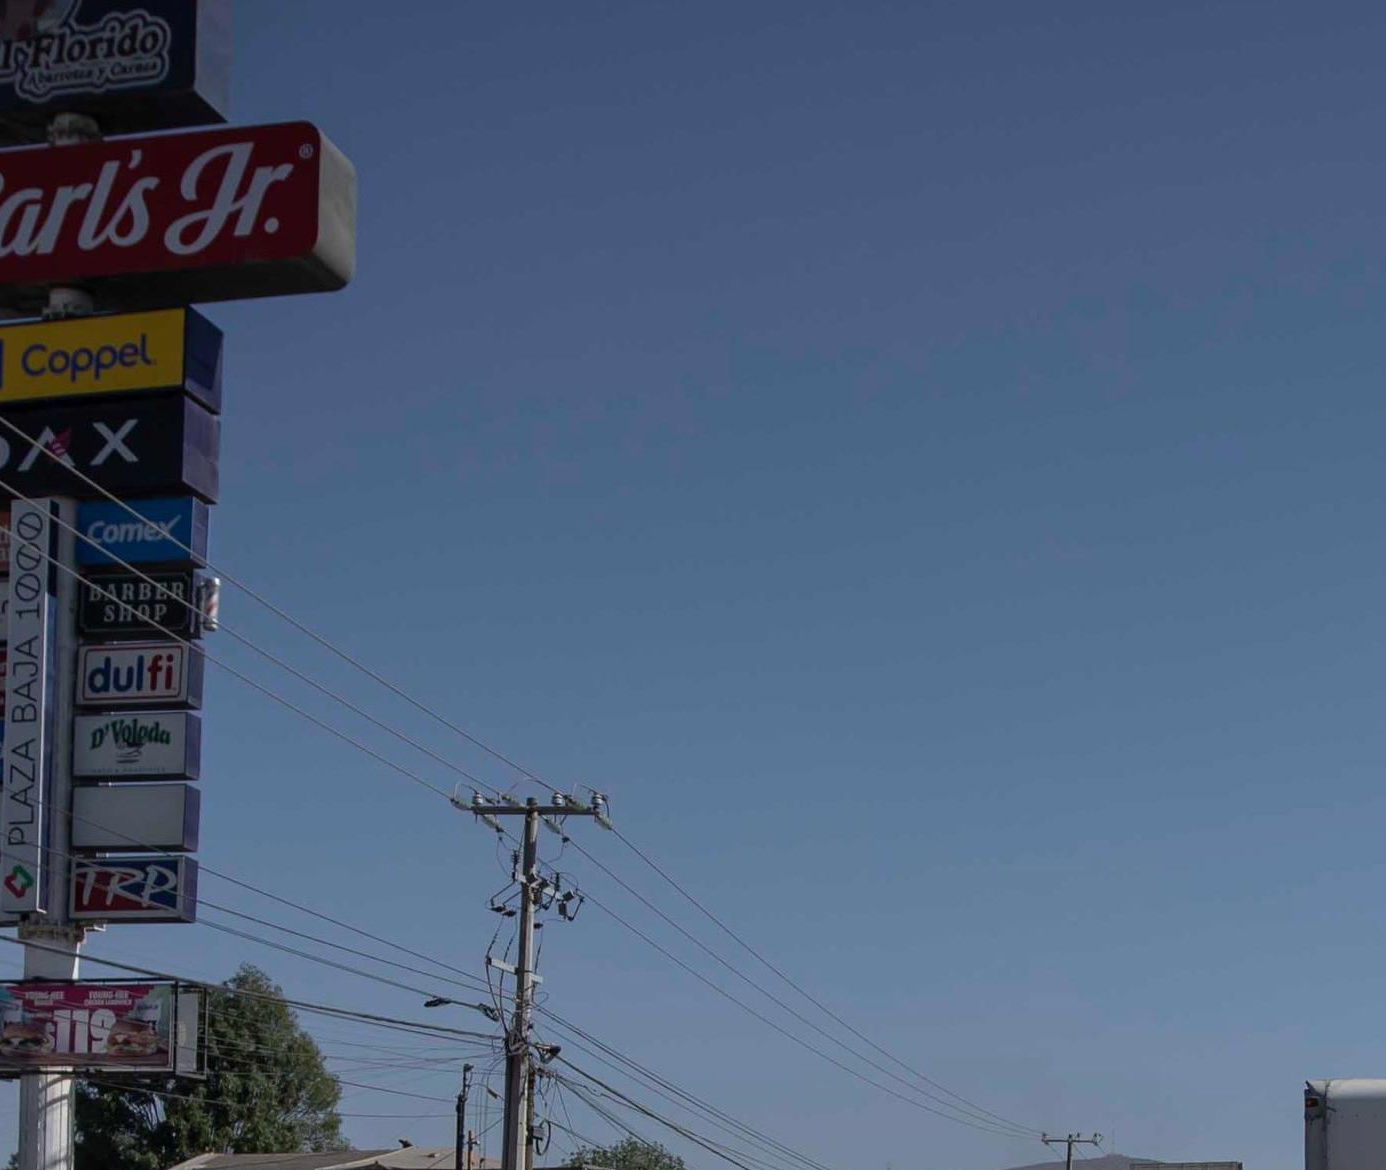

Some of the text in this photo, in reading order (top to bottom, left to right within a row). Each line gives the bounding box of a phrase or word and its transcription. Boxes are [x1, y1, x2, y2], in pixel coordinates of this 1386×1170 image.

[28, 25, 159, 67] Florido
[163, 142, 294, 256] Jr.
[21, 333, 152, 383] Coppel
[86, 514, 183, 544] Comex
[88, 581, 184, 602] BARBER
[103, 603, 168, 623] SHOP
[12, 635, 39, 724] BAJA
[88, 653, 174, 693] dulfi
[8, 738, 35, 846] PLAZA
